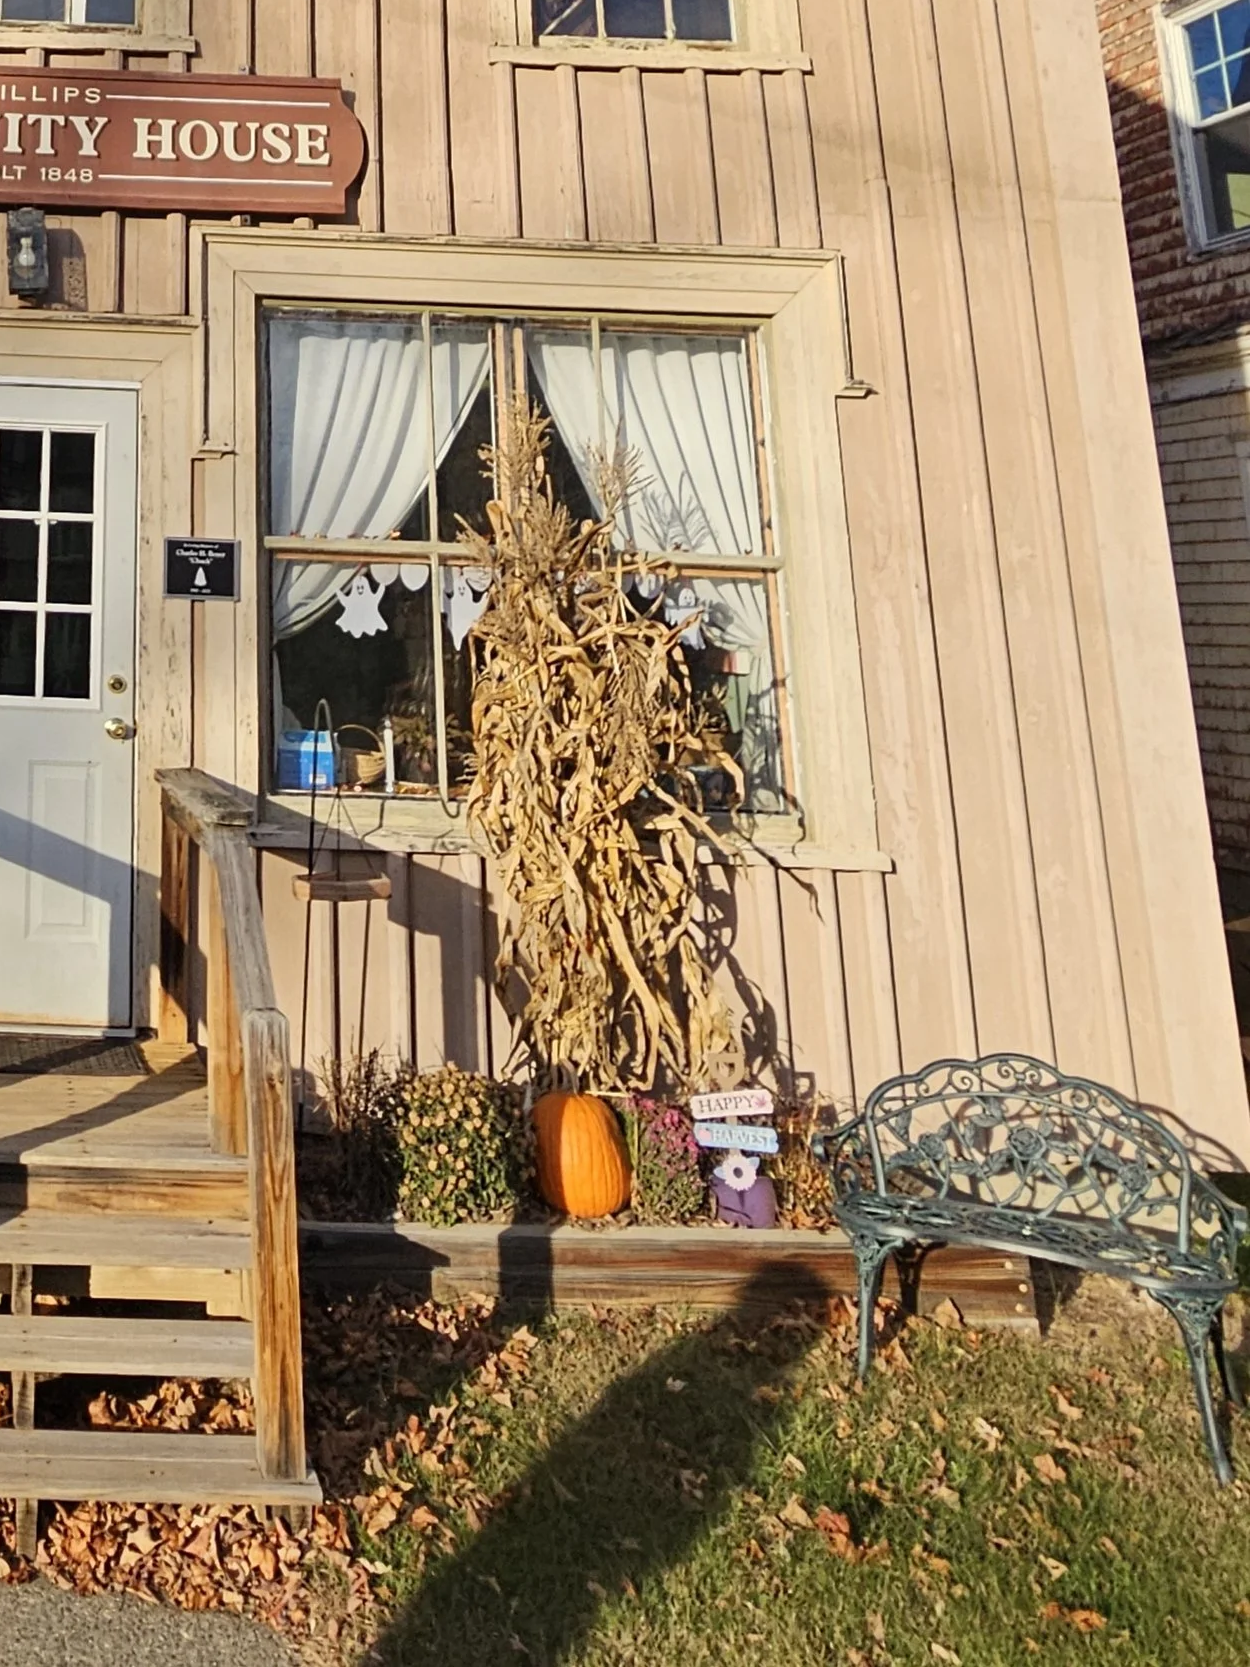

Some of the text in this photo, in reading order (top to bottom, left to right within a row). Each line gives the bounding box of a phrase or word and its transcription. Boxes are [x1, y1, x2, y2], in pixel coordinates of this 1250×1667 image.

[132, 117, 331, 166] HOUSE
[39, 166, 94, 183] 1848
[698, 1094, 754, 1113] HAPPY
[713, 1129, 769, 1147] HARVEST
